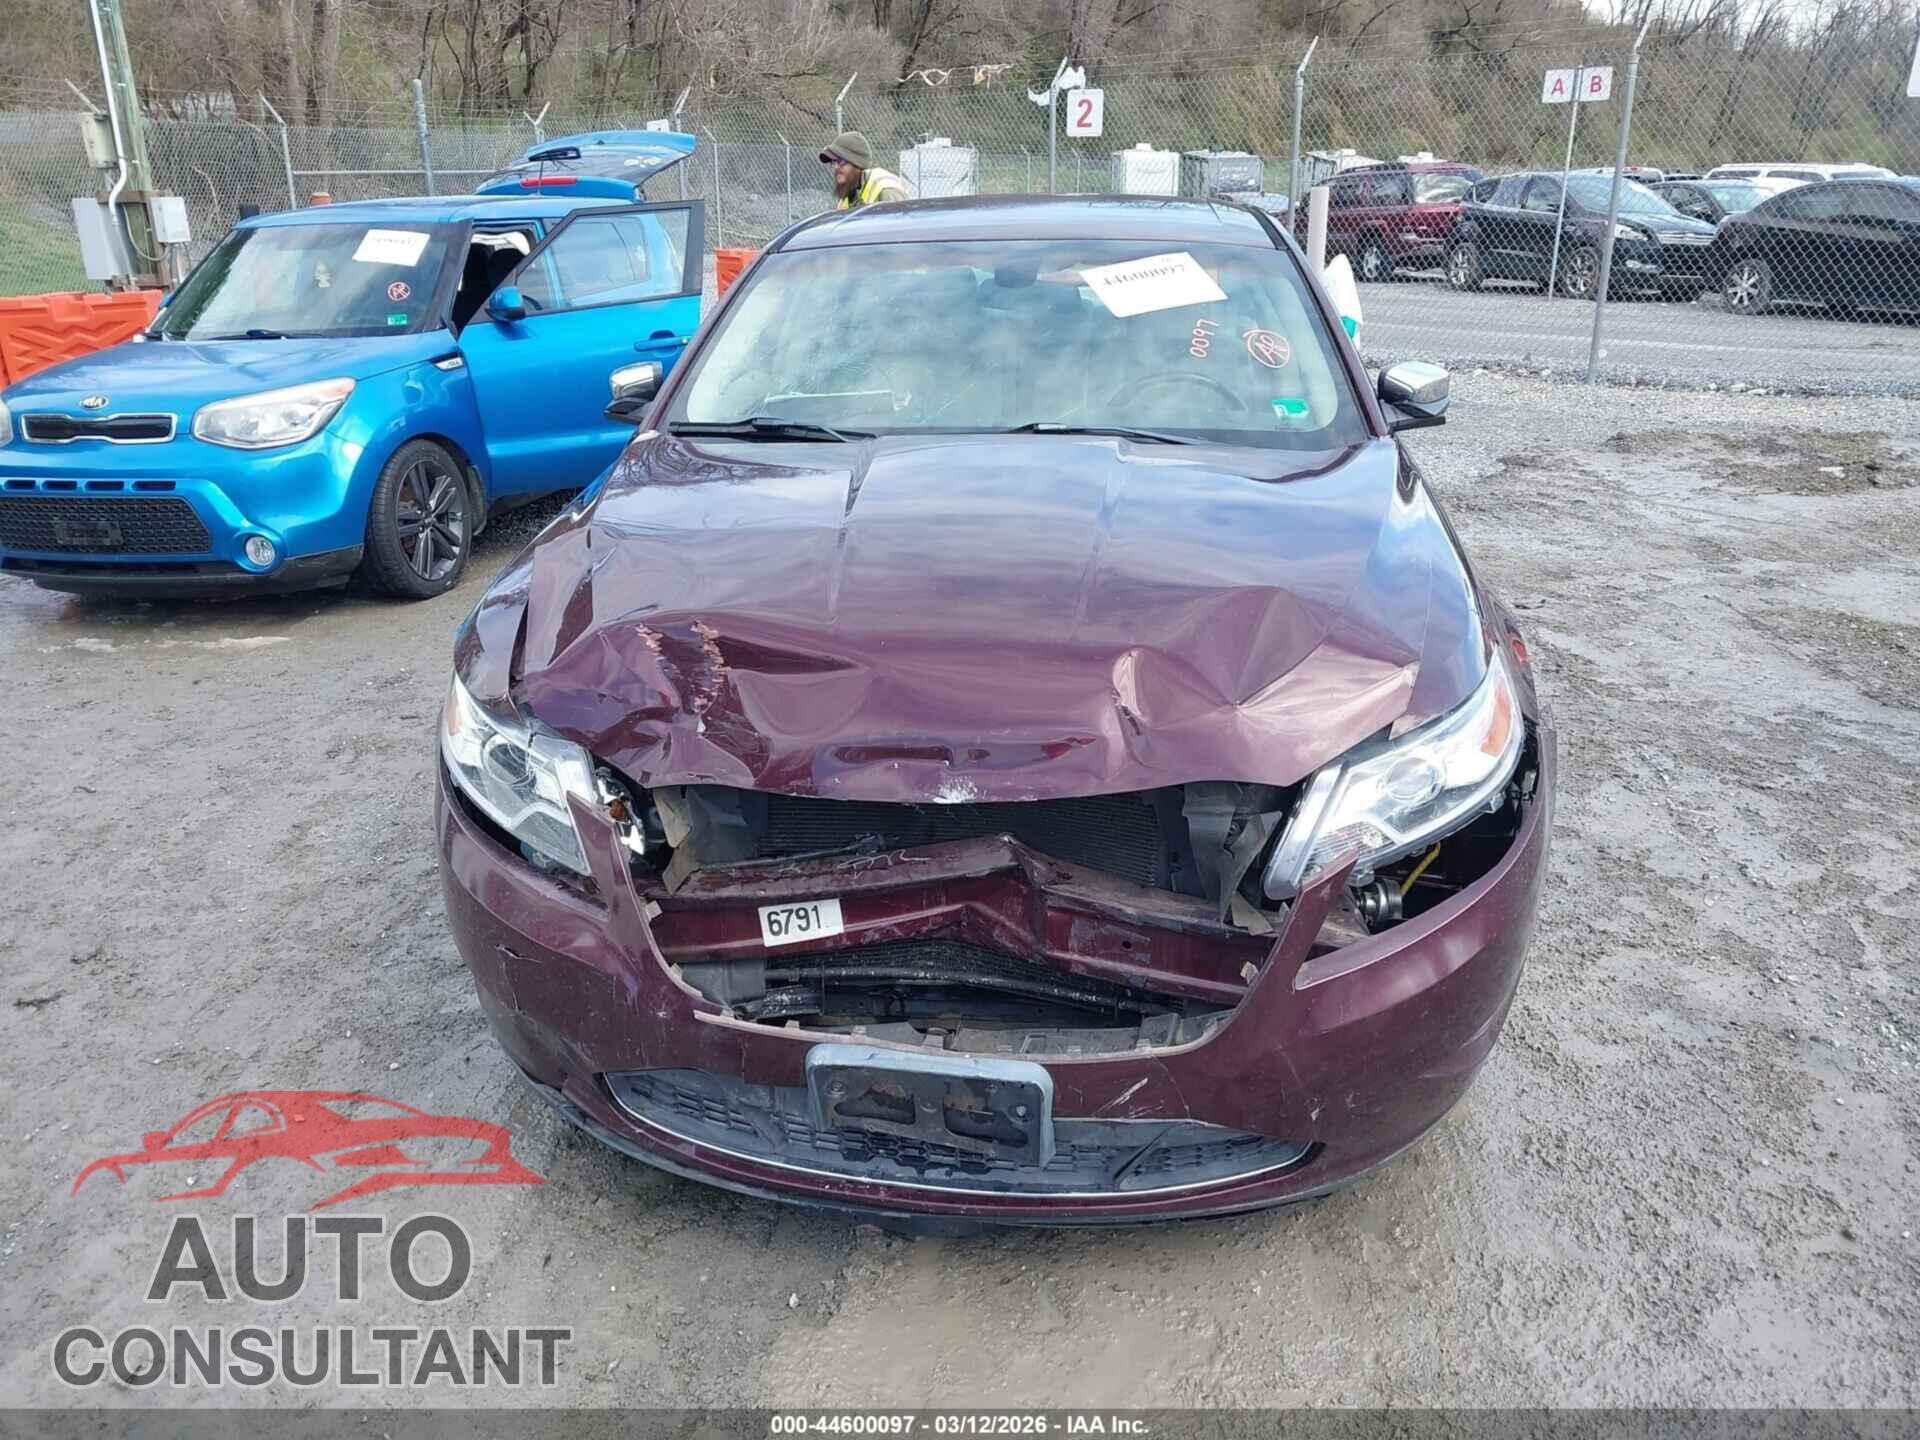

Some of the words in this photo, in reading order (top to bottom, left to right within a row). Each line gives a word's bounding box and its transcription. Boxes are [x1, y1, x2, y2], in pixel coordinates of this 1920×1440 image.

[1551, 78, 1564, 95] A
[1590, 75, 1602, 93] B
[1077, 98, 1093, 128] 2
[1189, 318, 1220, 358] 0097
[767, 905, 822, 937] 6791
